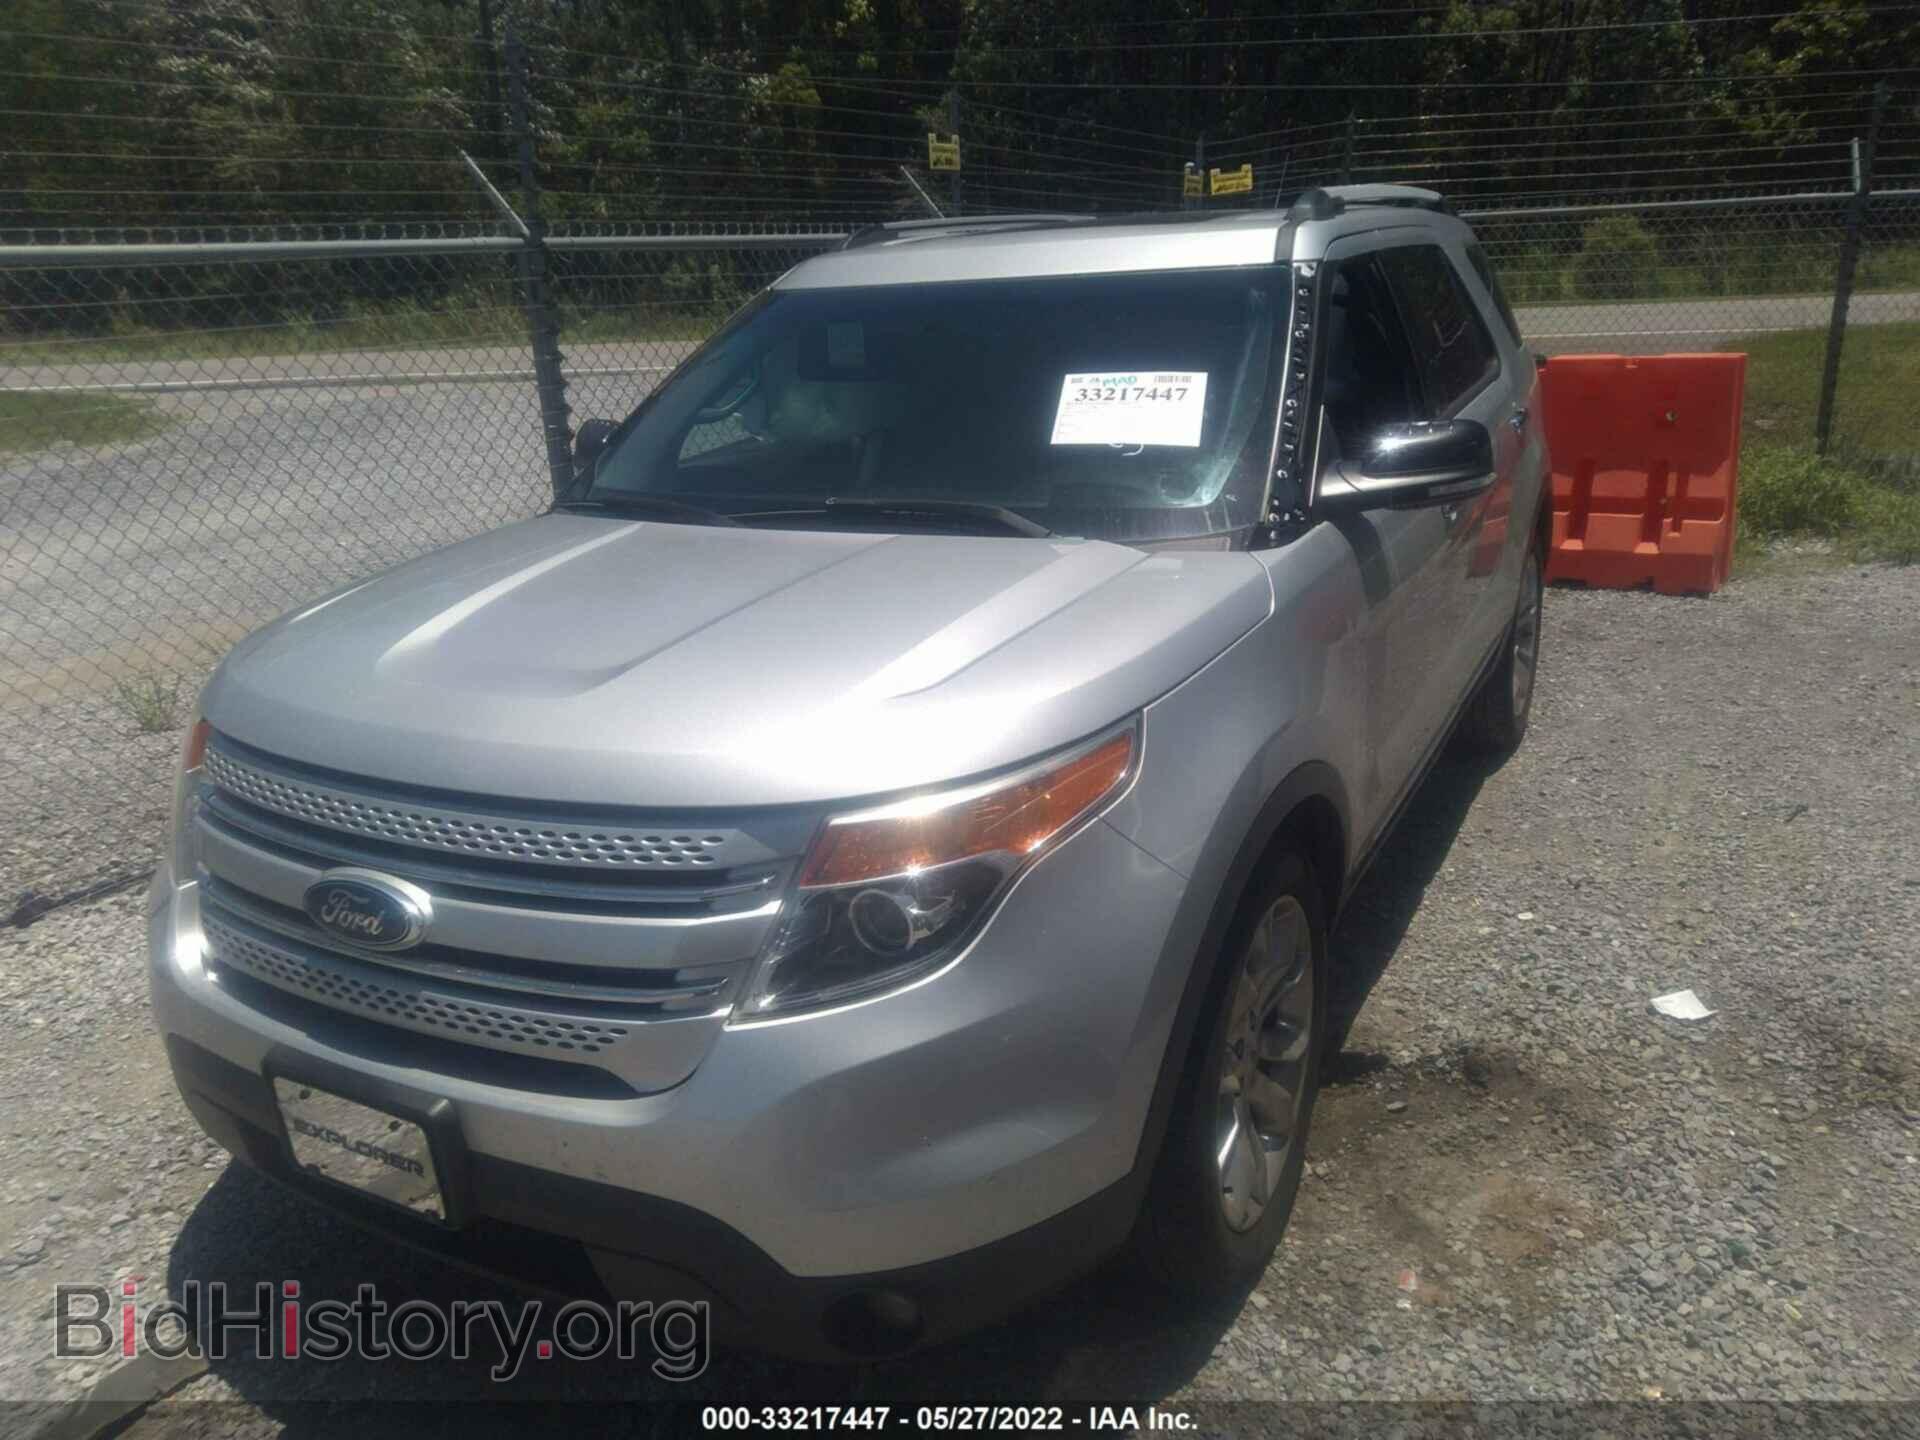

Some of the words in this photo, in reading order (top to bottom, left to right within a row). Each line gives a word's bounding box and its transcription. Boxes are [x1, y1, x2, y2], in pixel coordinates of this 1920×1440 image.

[1075, 387, 1189, 402] 33217447
[320, 888, 384, 936] Ford
[294, 1119, 425, 1177] EXPLORER
